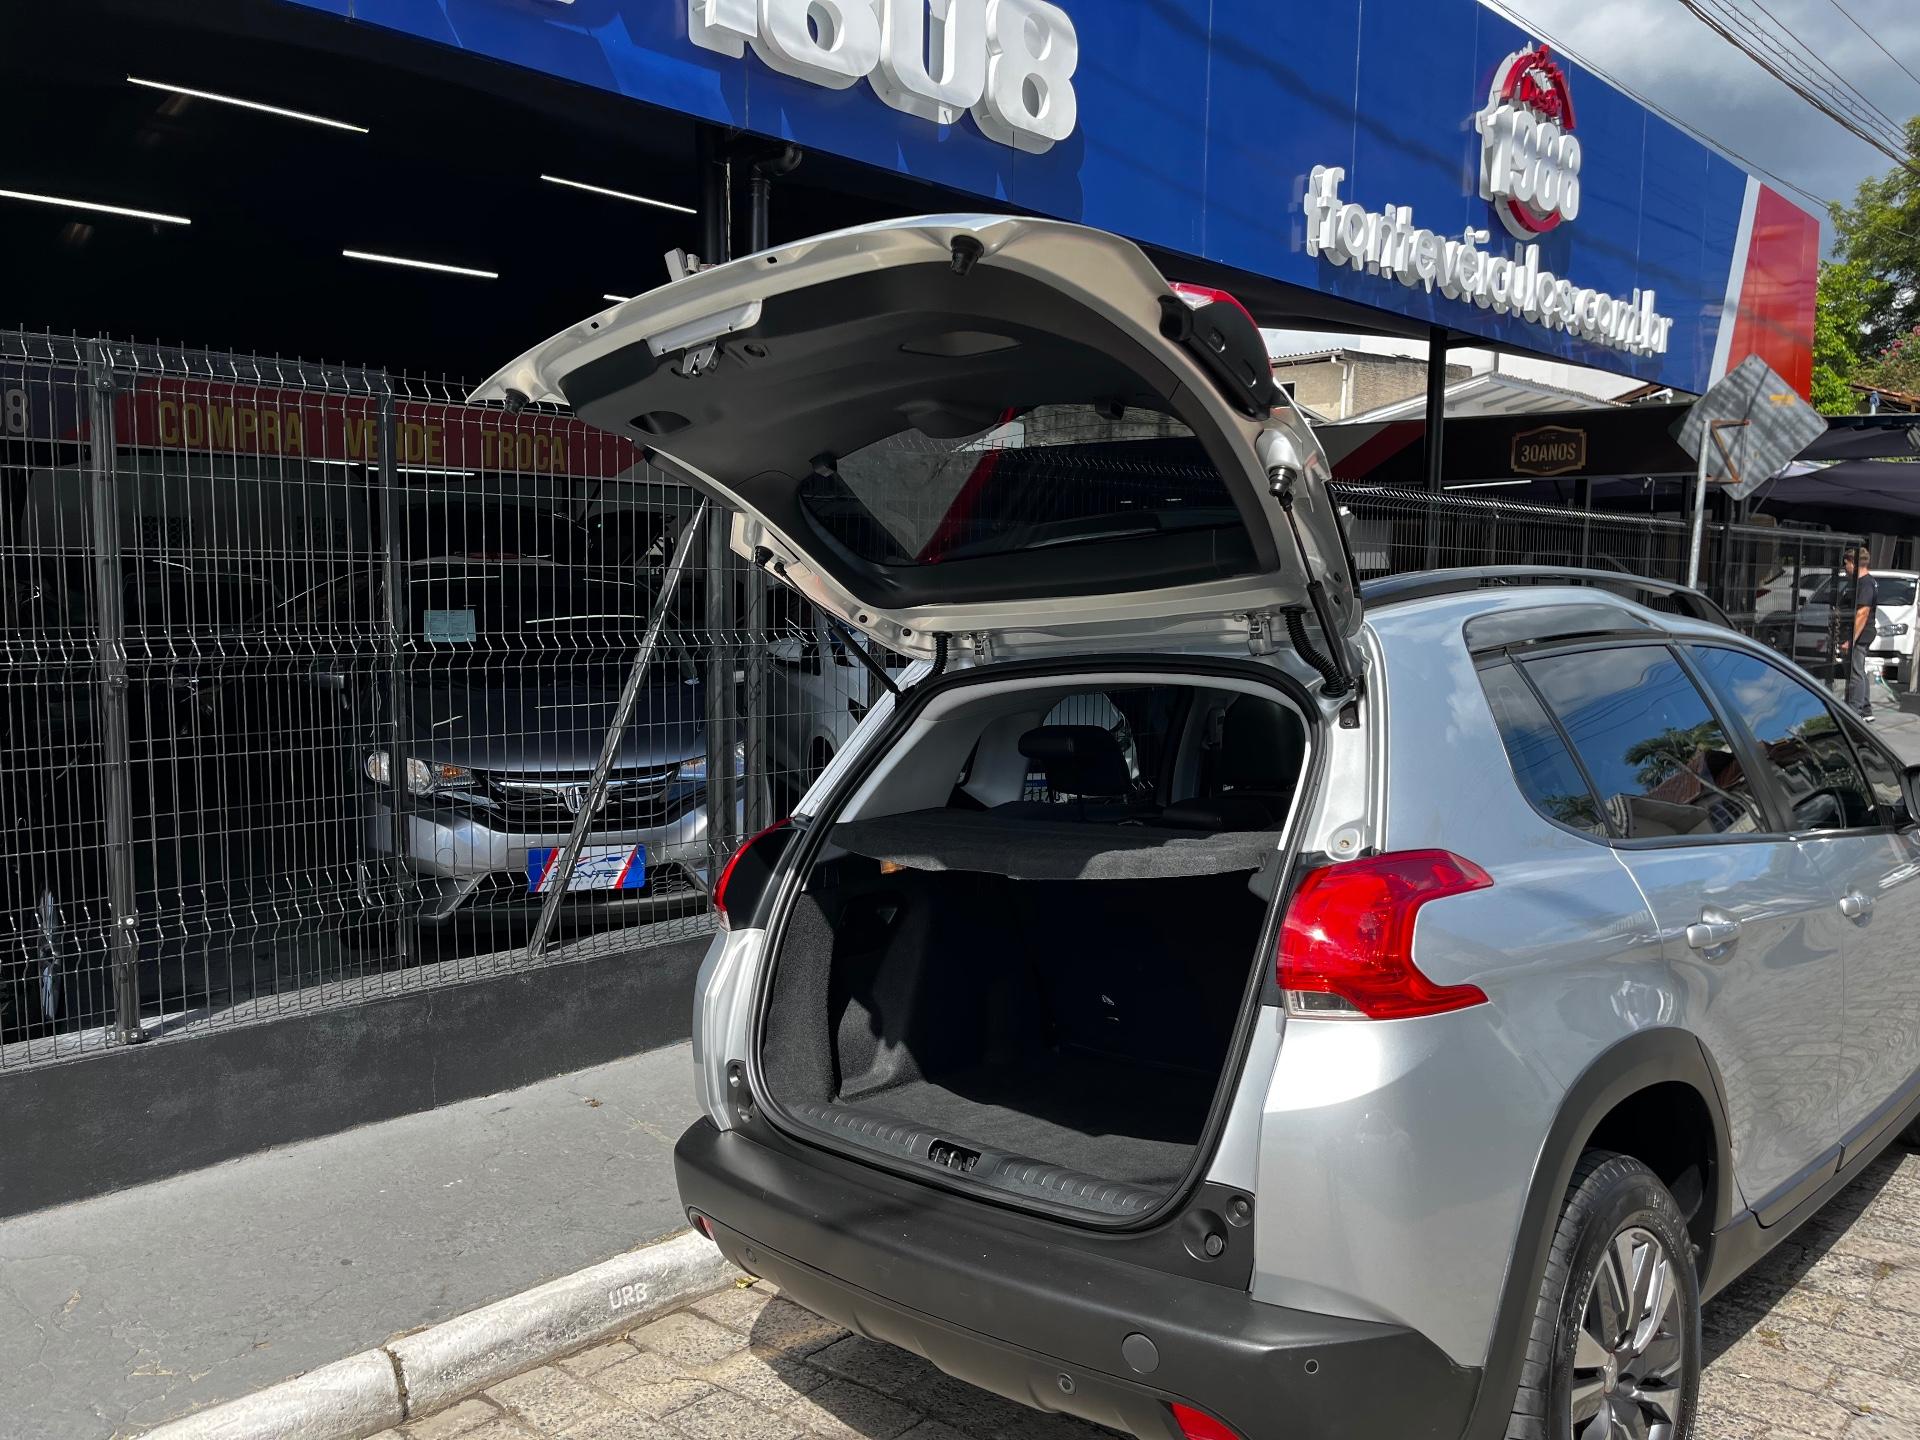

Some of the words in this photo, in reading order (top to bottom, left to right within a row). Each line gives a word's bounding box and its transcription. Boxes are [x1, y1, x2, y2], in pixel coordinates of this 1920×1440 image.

[689, 0, 1079, 153] 608
[1479, 105, 1581, 221] 1988
[159, 400, 302, 450] COMPRA
[481, 430, 566, 472] TROCA
[608, 1282, 648, 1310] URB
